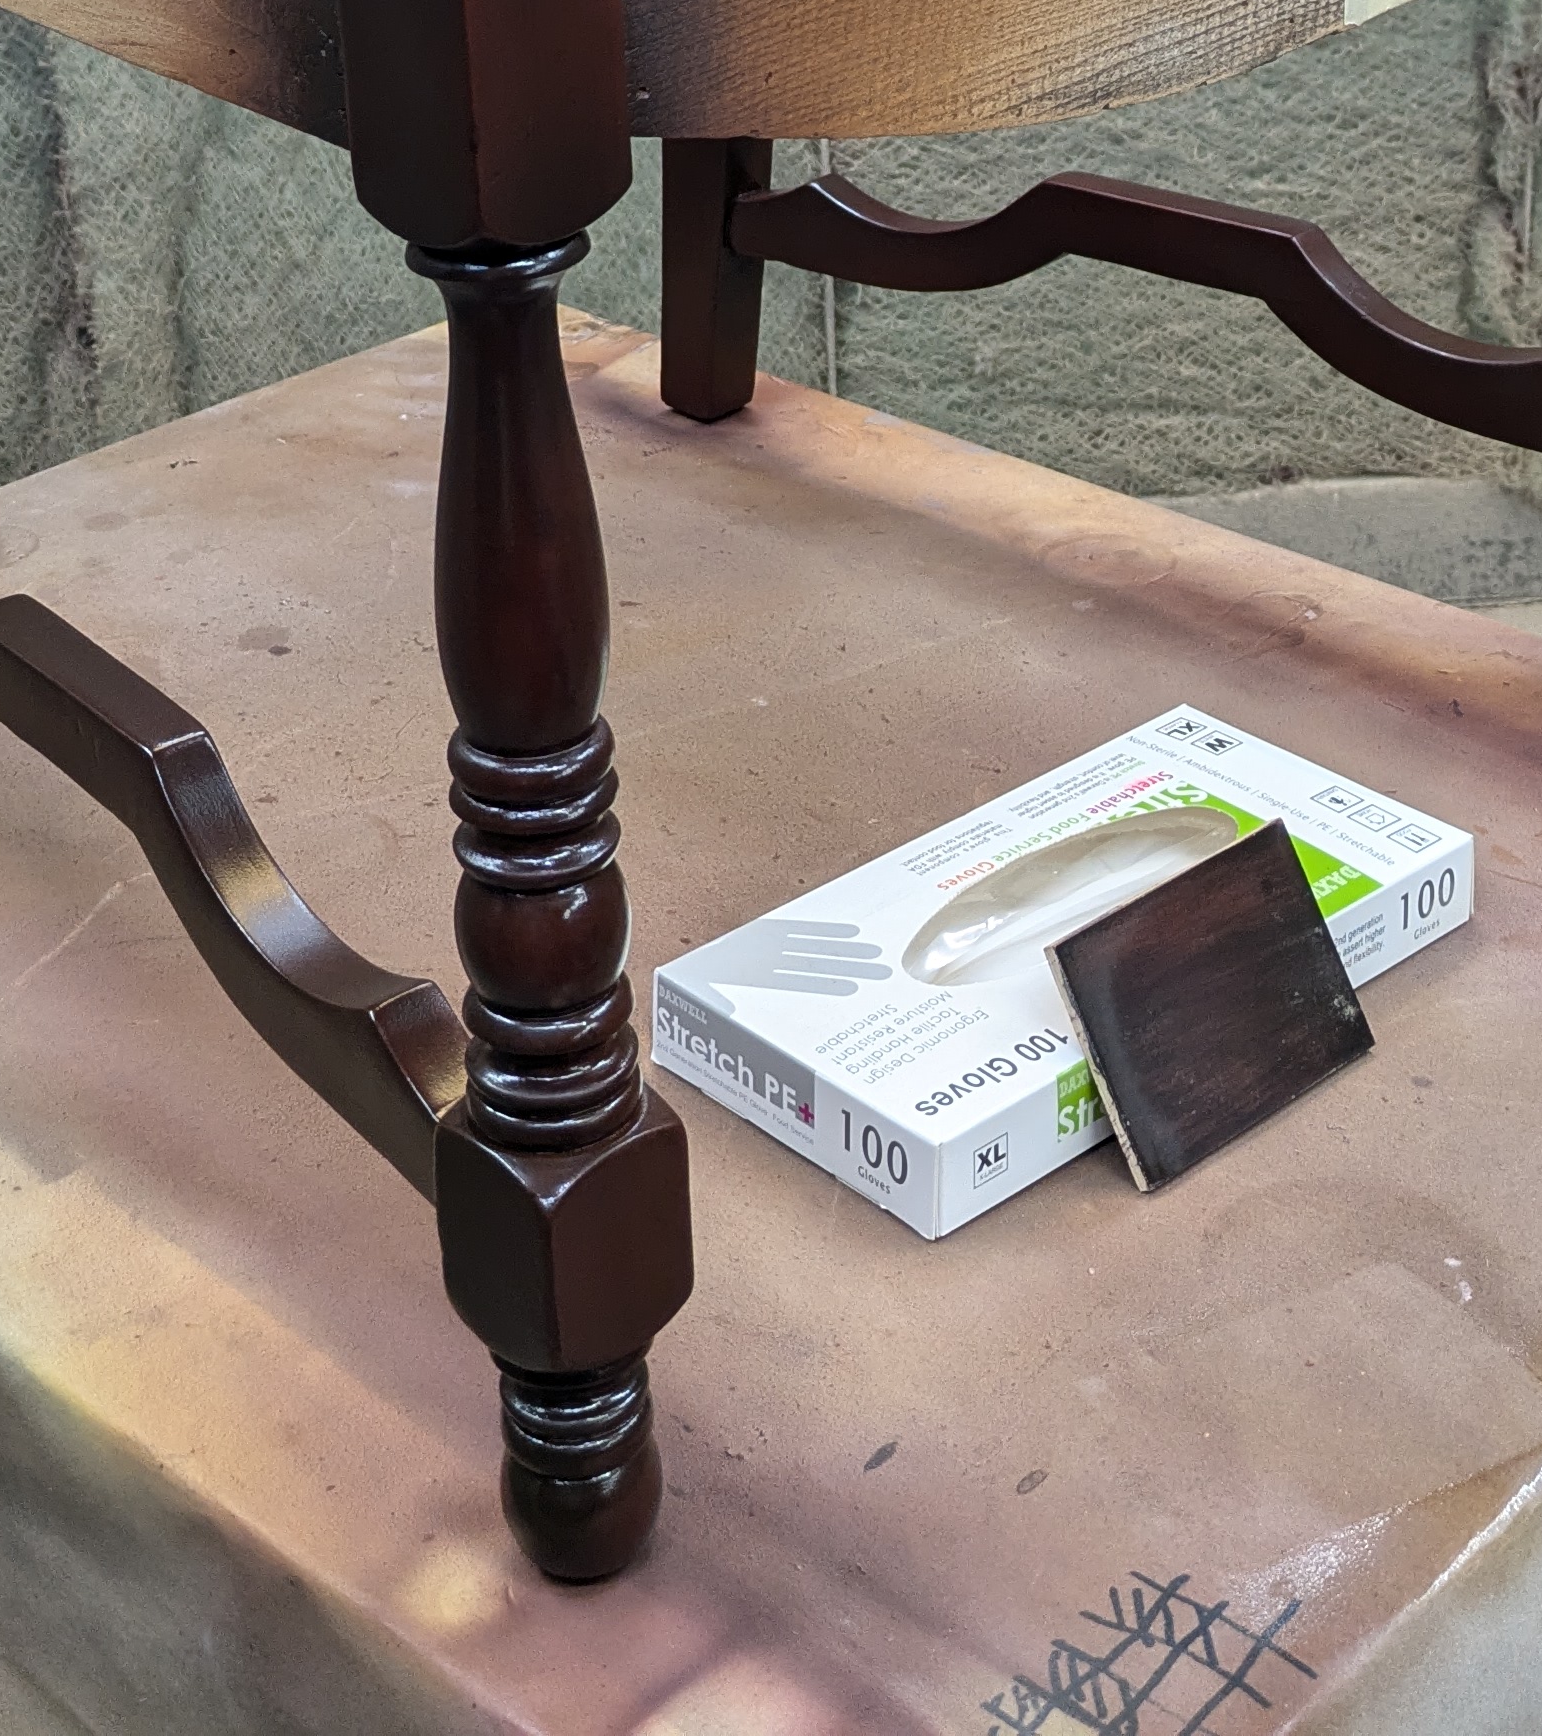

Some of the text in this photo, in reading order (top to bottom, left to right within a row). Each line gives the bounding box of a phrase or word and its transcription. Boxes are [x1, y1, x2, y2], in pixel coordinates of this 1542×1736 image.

[1164, 721, 1200, 739] XL
[1205, 738, 1234, 752] W
[937, 771, 1174, 890] Stretchable Food Service Gloves
[1126, 735, 1395, 865] Non-Sterile Ambidextrous Single-Use PE Stretchable
[1401, 868, 1455, 930] 100
[1414, 919, 1440, 940] Gloves
[658, 982, 708, 1026] DAXWELL
[815, 1004, 898, 1054] Stretchable
[831, 991, 953, 1065] Moisture Resistant
[656, 1006, 754, 1089] Stretch
[845, 1007, 961, 1075] Tactile Handling
[863, 1009, 989, 1084] Ergonomic Design
[915, 1028, 1068, 1116] 100 Gloves
[841, 1109, 908, 1185] 100
[977, 1142, 1007, 1173] XL
[858, 1166, 890, 1194] Gloves
